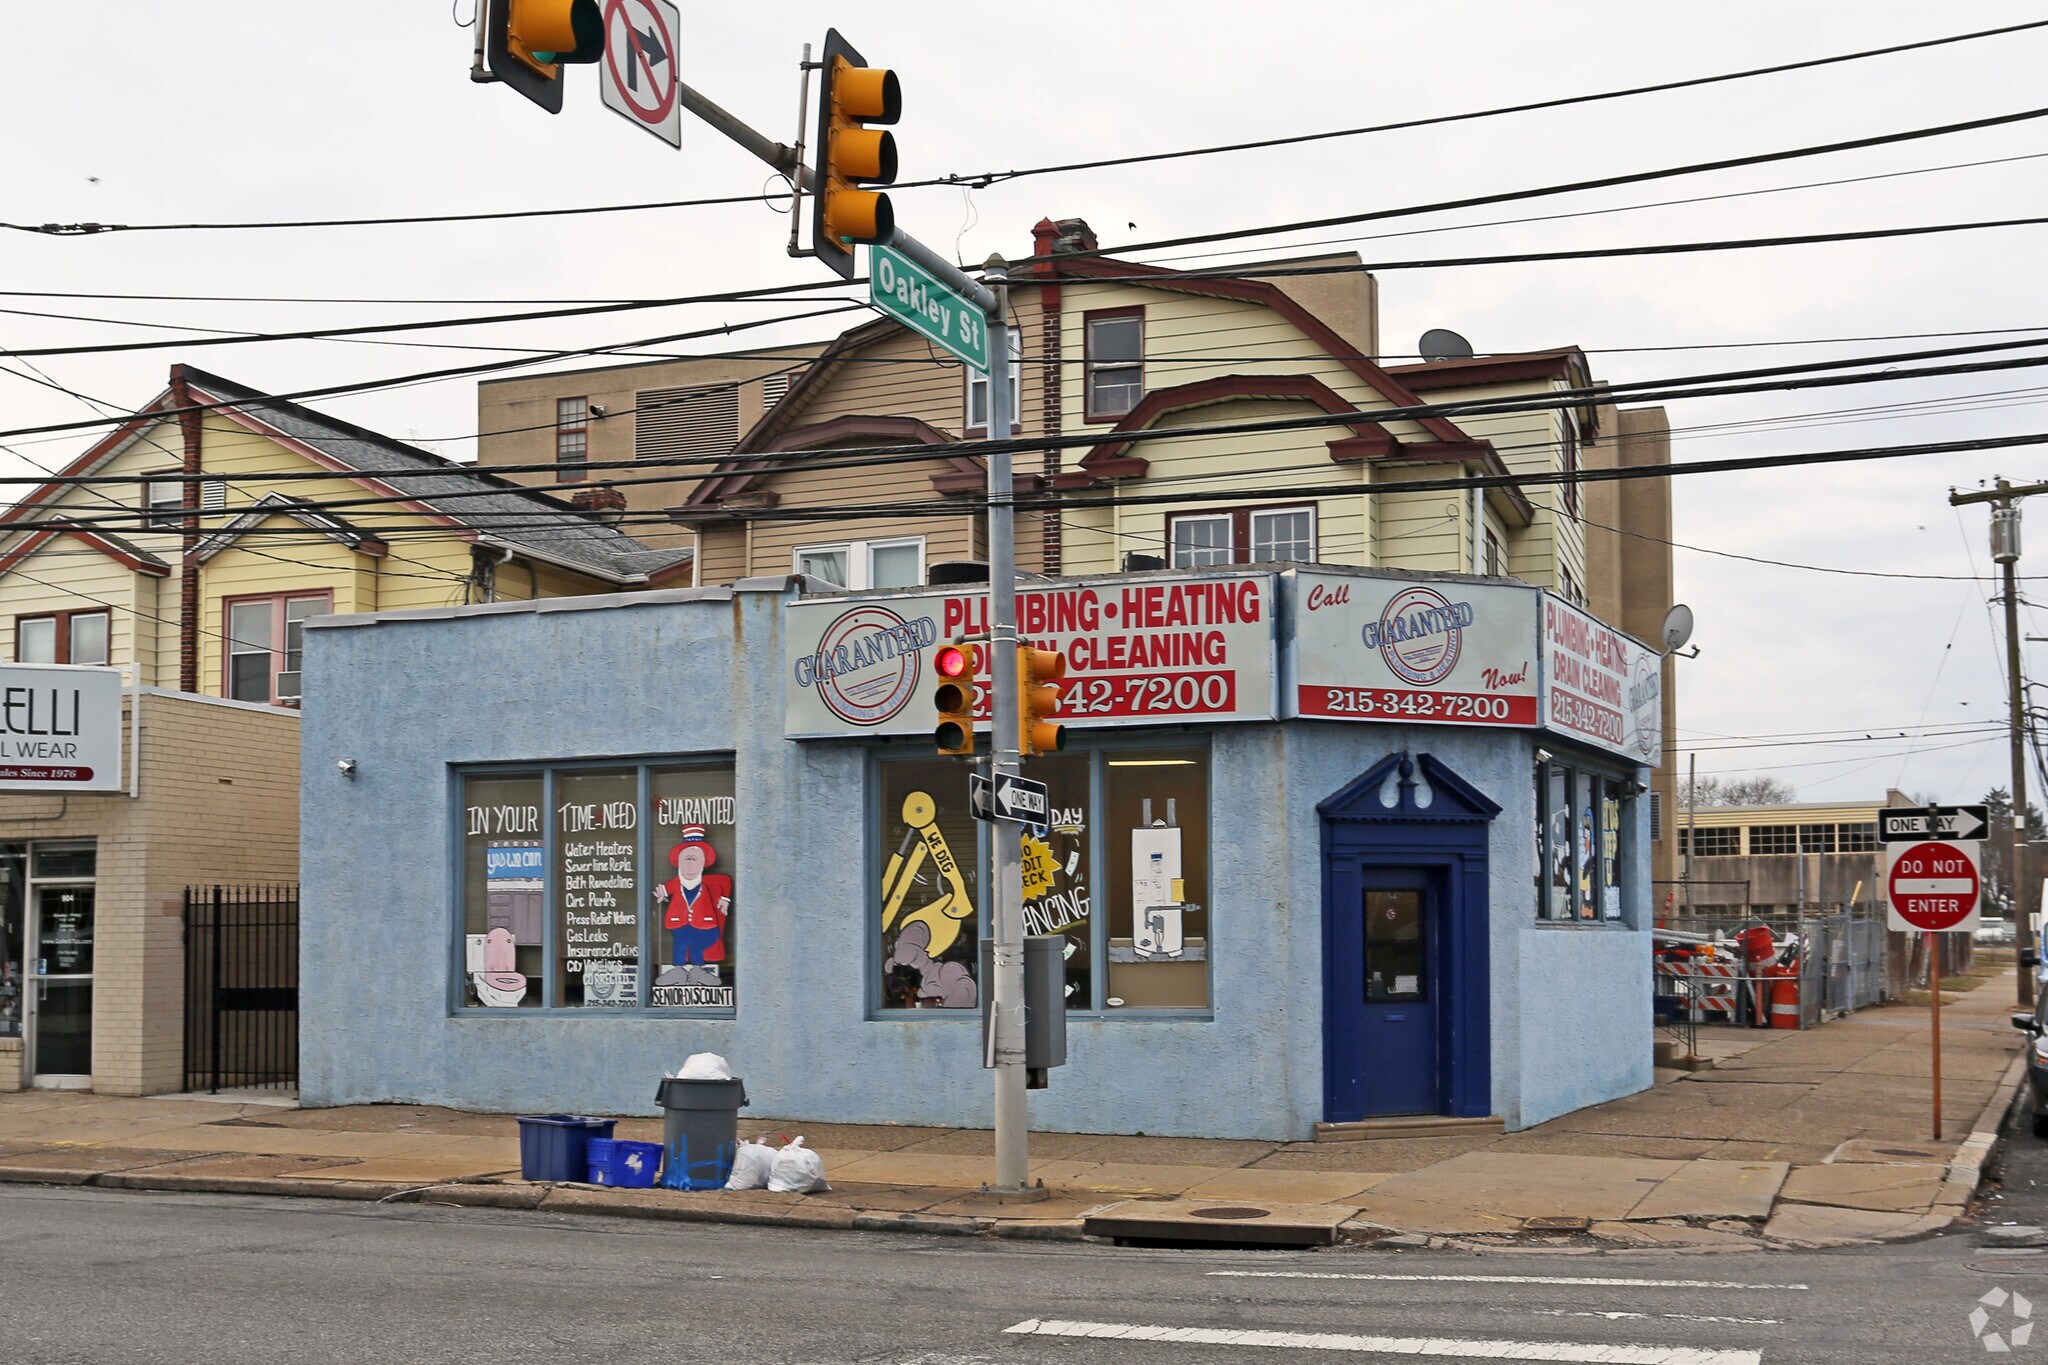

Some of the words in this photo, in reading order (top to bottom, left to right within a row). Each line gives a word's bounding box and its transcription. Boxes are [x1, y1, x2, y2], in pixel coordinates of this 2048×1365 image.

[880, 257, 951, 336] Oakley
[960, 310, 979, 351] St
[1122, 580, 1260, 629] HEATING
[1307, 584, 1350, 611] Call
[1361, 601, 1474, 650] GUARANTEED
[1546, 600, 1591, 660] PLUMBING
[1595, 627, 1628, 678] HEATING
[794, 616, 937, 688] GUARANTEED
[1068, 630, 1227, 671] CLEANING
[1387, 650, 1427, 681] PLUMBING
[1429, 671, 1436, 679] &
[1436, 634, 1457, 674] HEATING
[1481, 661, 1528, 690] Now!
[1553, 650, 1581, 690] DRAIN
[1582, 664, 1622, 708] CLEANING
[827, 683, 876, 718] PLUMBING
[878, 705, 887, 716] &
[888, 657, 914, 709] HEATING
[1326, 689, 1509, 720] 215-342-7200
[1553, 691, 1623, 744] 215-342-7200
[16, 742, 77, 759] WEAR
[20, 768, 48, 778] Since
[50, 769, 77, 779] 1976
[1012, 790, 1027, 808] ONE
[1028, 791, 1043, 812] WAY
[467, 805, 490, 836] IN
[493, 805, 538, 835] YOUR
[558, 801, 597, 833] TIME
[602, 801, 637, 830] NEED
[658, 796, 736, 825] GUARANTEED
[1051, 808, 1083, 825] DAY
[1890, 818, 1920, 832] ONE
[565, 842, 595, 857] Water
[595, 841, 634, 856] Heaters
[927, 831, 942, 849] WE
[935, 849, 954, 873] DIG
[522, 851, 542, 867] can
[565, 858, 592, 873] Sewer
[1902, 860, 1923, 874] DO
[1933, 860, 1965, 874] NOT
[565, 875, 587, 890] Bath
[61, 894, 75, 902] 904
[565, 892, 586, 908] Circ
[1908, 899, 1959, 912] ENTER
[566, 911, 590, 925] Press
[590, 910, 612, 925] Relief
[612, 911, 636, 925] Valves
[566, 928, 584, 942] Gas
[584, 928, 609, 942] Leaks
[567, 943, 612, 957] Insurance
[566, 960, 583, 973] City
[586, 999, 638, 1008] 215-342-7200
